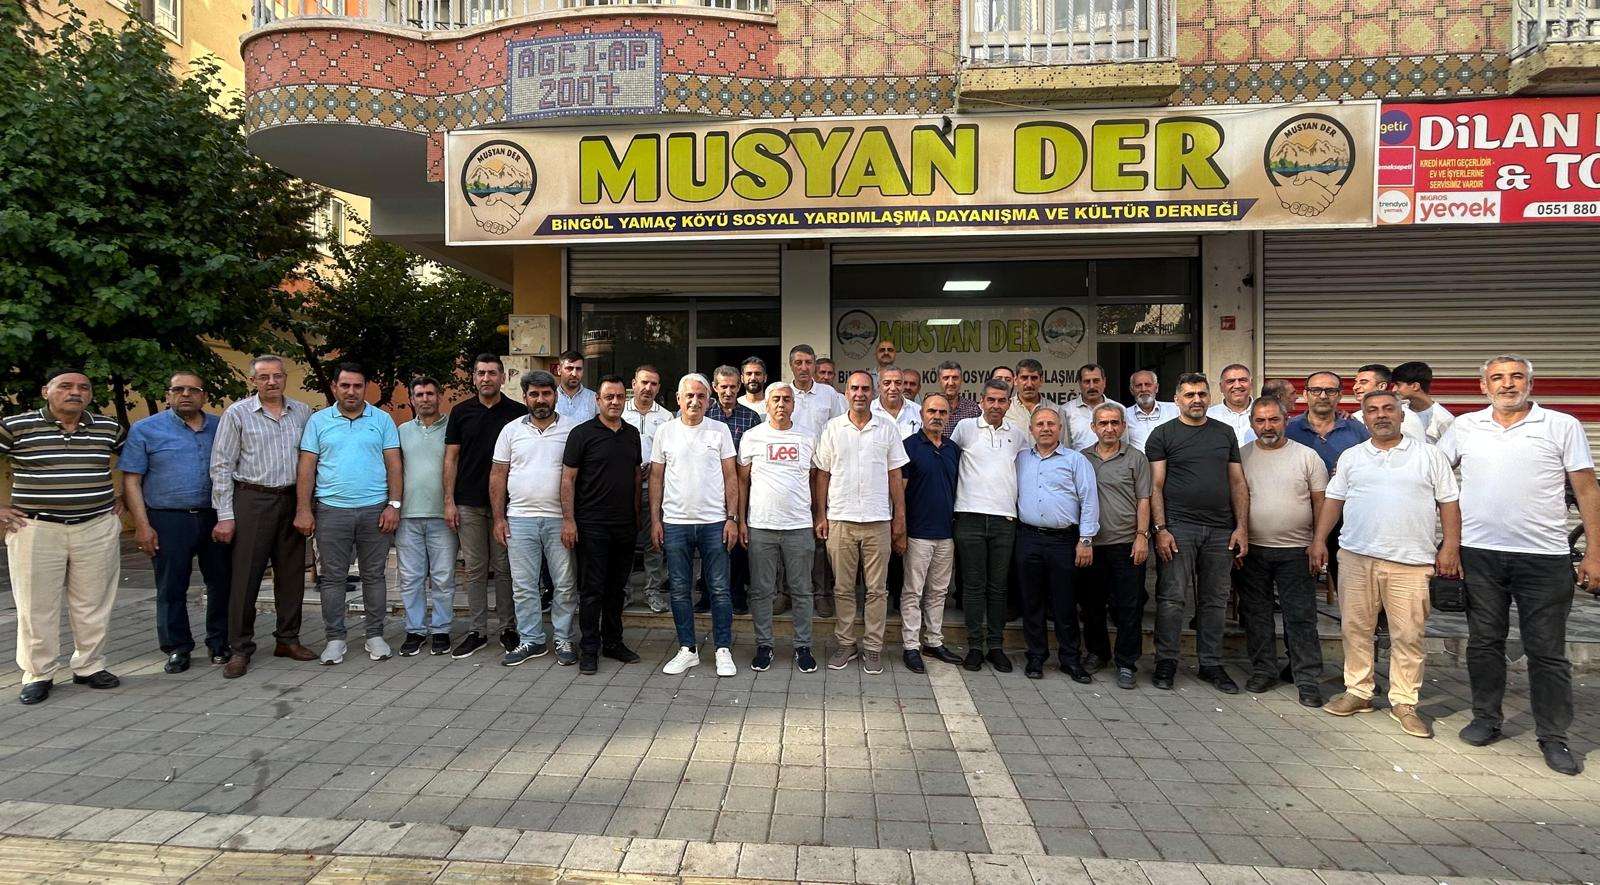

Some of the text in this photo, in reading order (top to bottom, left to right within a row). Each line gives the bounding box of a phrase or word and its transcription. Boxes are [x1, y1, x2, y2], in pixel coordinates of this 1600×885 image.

[539, 73, 620, 110] 2007
[1284, 122, 1337, 138] MUSYAN DER
[1380, 121, 1408, 134] getir
[477, 148, 521, 163] MUSYAN DER
[579, 116, 1230, 204] MUSYAN DER
[1496, 164, 1531, 190] &
[618, 216, 677, 230] YAMAÇ
[682, 213, 728, 228] KÖYÜ
[732, 212, 799, 226] SOSYAL
[804, 210, 931, 226] YARDIMLAŞMA
[935, 208, 1040, 224] DAYANIŞMA
[1045, 207, 1069, 220] VE
[1075, 204, 1150, 219] KÜLTÜR
[1155, 201, 1238, 218] DERNEĞİ
[1420, 198, 1496, 222] yemek
[1537, 204, 1597, 215] 0551 880
[878, 318, 1041, 353] MUSYAN DER
[768, 445, 798, 460] Lee
